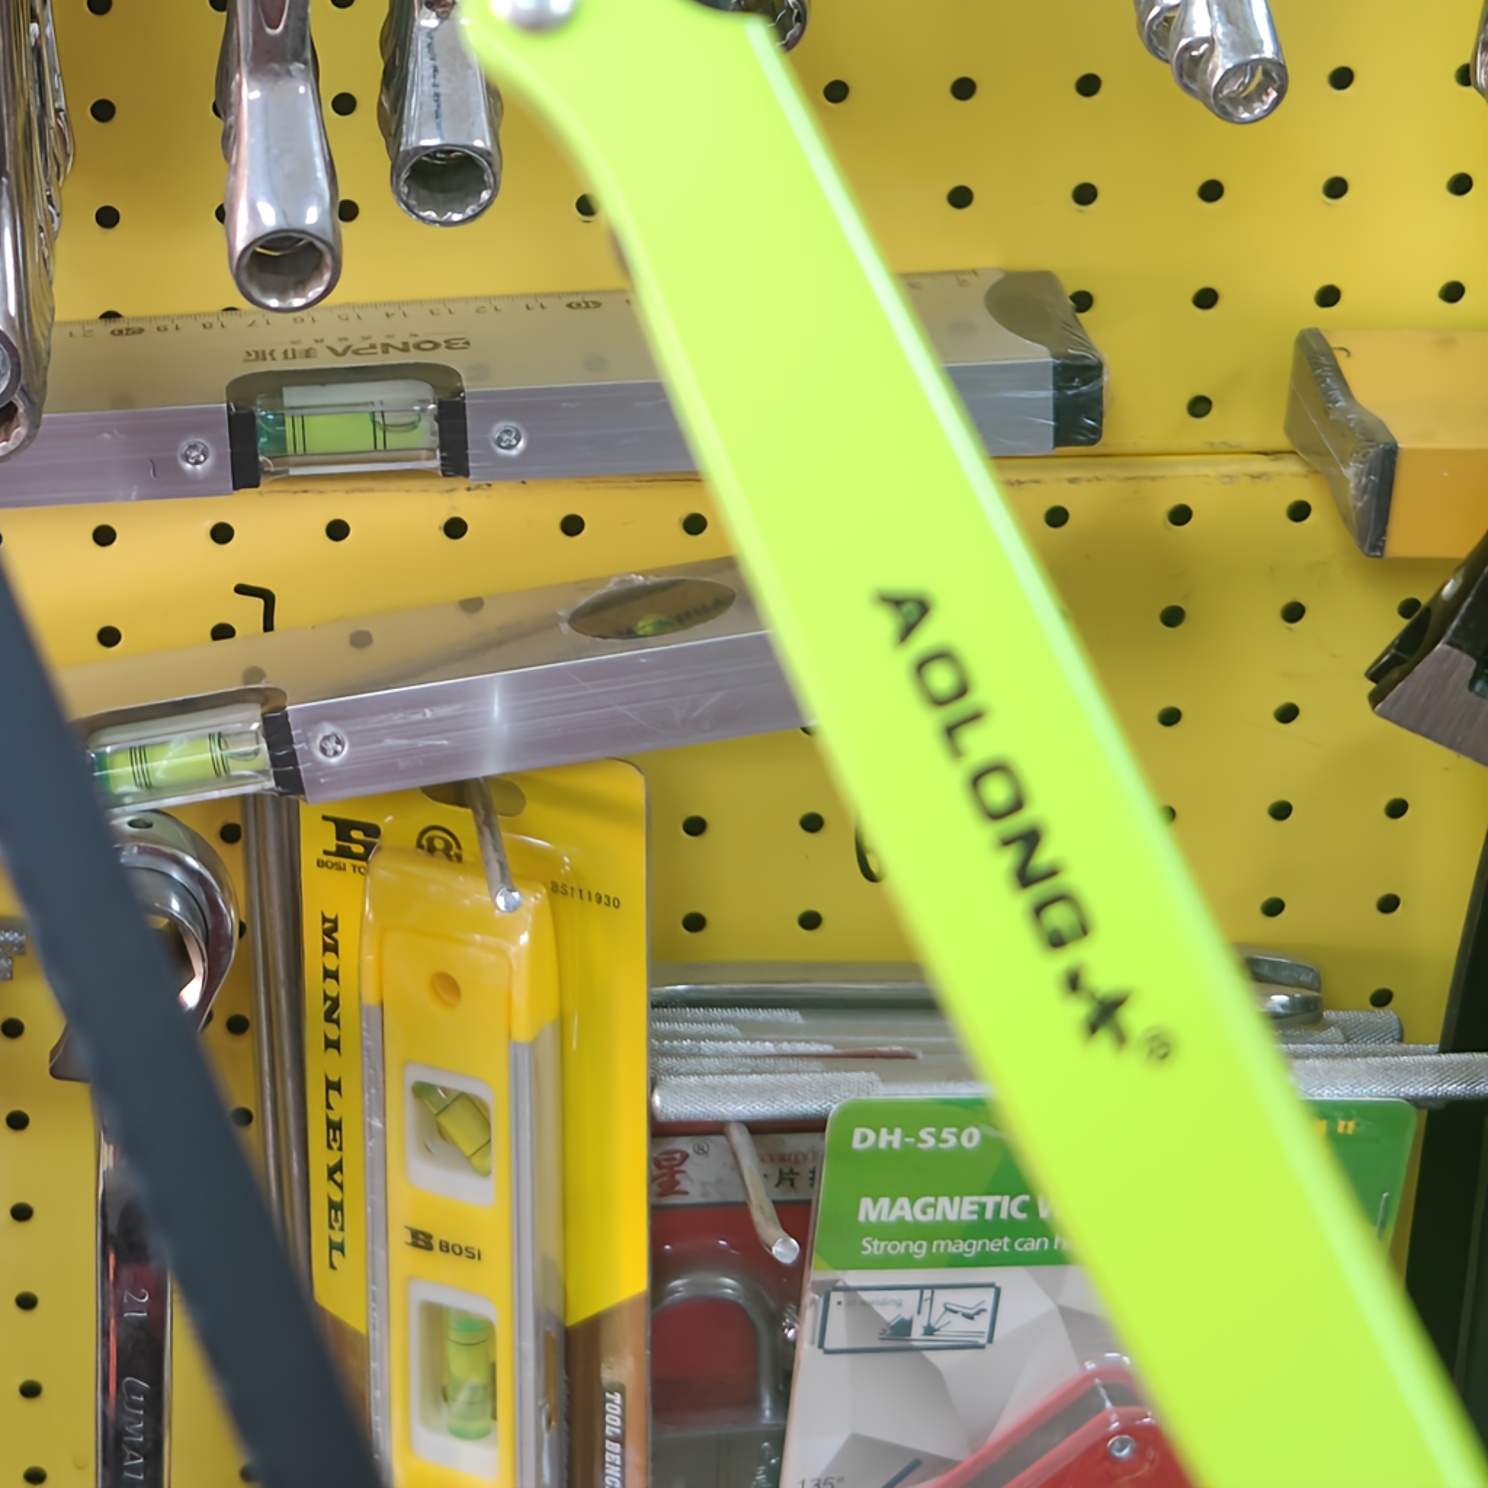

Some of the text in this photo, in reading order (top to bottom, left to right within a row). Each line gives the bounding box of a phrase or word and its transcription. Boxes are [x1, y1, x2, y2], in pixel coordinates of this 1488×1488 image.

[873, 587, 1092, 951] AOLONG
[316, 858, 347, 873] BOSI
[321, 909, 347, 1272] MINI LEVEL
[852, 1126, 982, 1151] DH-S50
[857, 1194, 1031, 1223] MAGNETIC
[438, 1239, 482, 1262] BOSI
[860, 1236, 927, 1259] Strong
[931, 1235, 1012, 1258] magnet
[1014, 1237, 1049, 1252] can
[123, 1287, 150, 1320] 21
[604, 1391, 622, 1437] TOOL
